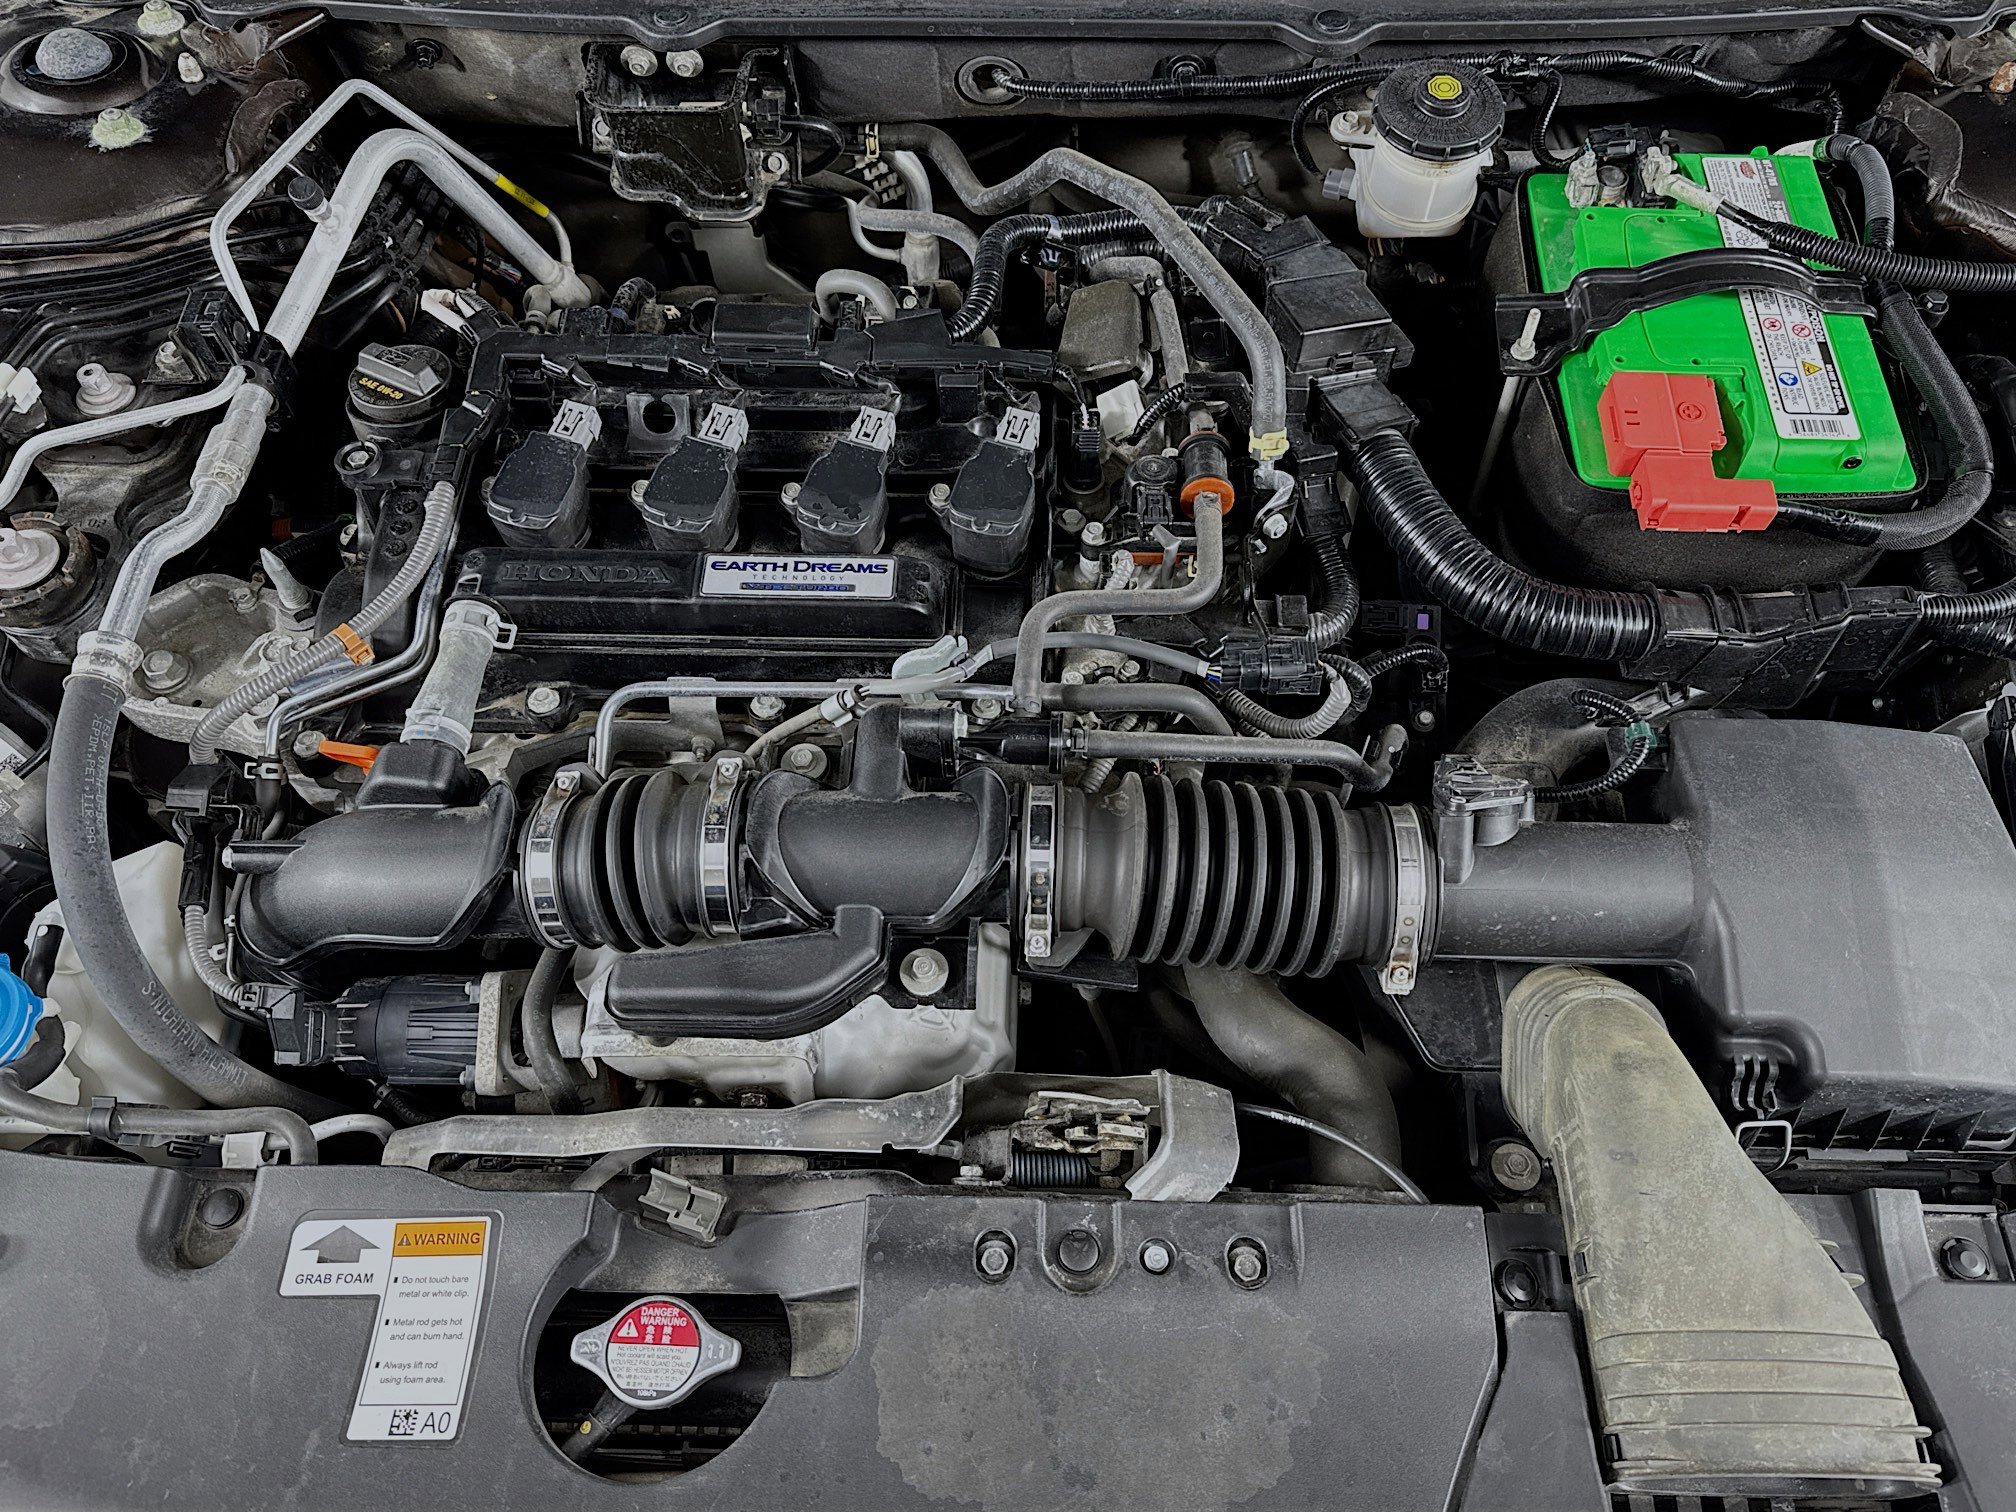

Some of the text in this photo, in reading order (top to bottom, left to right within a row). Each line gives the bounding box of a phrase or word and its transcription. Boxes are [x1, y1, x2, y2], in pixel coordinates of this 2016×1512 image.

[359, 377, 380, 390] SAE
[710, 559, 889, 573] EARTH DREAMS
[502, 562, 673, 585] HONDA
[752, 574, 846, 582] TECHNOLOGY
[414, 1232, 480, 1246] WARNING
[295, 1272, 374, 1285] GRAB FOAM
[401, 1275, 469, 1284] Do not touch bare
[398, 1289, 421, 1298] metal
[431, 1289, 453, 1298] white
[453, 1289, 470, 1300] clip.
[640, 1306, 680, 1318] DANGER
[392, 1317, 463, 1328] Metal rod gets hot
[639, 1315, 687, 1327] WARNUNG
[389, 1331, 465, 1341] and can burn hand.
[382, 1361, 438, 1371] Always lift rod
[379, 1375, 447, 1385] using foam area.
